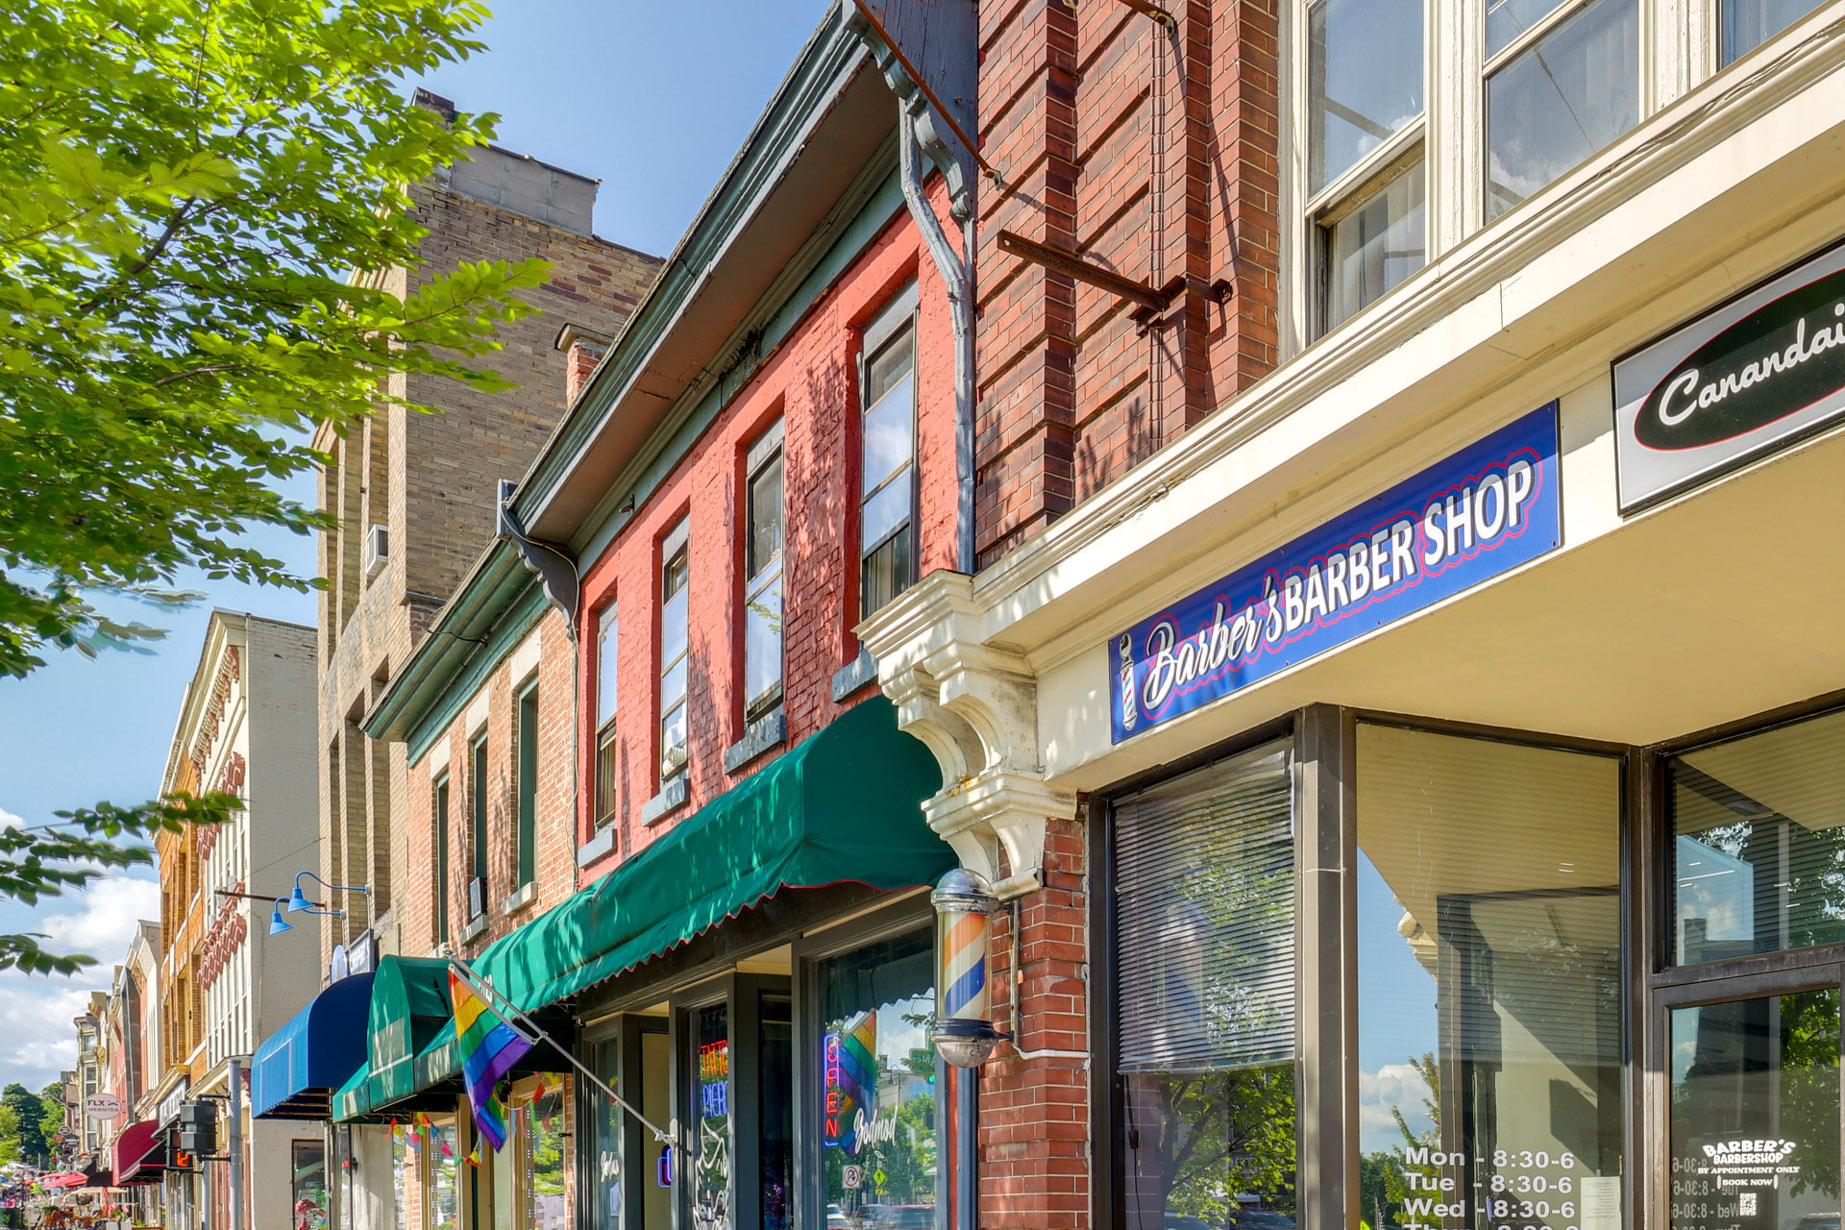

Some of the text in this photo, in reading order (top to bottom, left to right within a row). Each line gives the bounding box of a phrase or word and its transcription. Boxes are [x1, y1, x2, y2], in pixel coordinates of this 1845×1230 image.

[1143, 459, 1537, 711] Barber's BARBER SHOP
[87, 1099, 106, 1107] FLX
[1405, 1147, 1465, 1166] Mon
[1492, 1150, 1575, 1169] 8:30-6
[1702, 1139, 1796, 1158] BARBER'S
[1713, 1152, 1784, 1165] BARBERSHOP
[1697, 1166, 1801, 1175] BY APPOINTMENT ONLY
[1404, 1172, 1455, 1191] Tue
[1490, 1174, 1573, 1194] 8:30-6
[1722, 1178, 1774, 1186] BOOK NOW
[1403, 1197, 1466, 1217] Wed
[1493, 1200, 1576, 1218] 8:30-6
